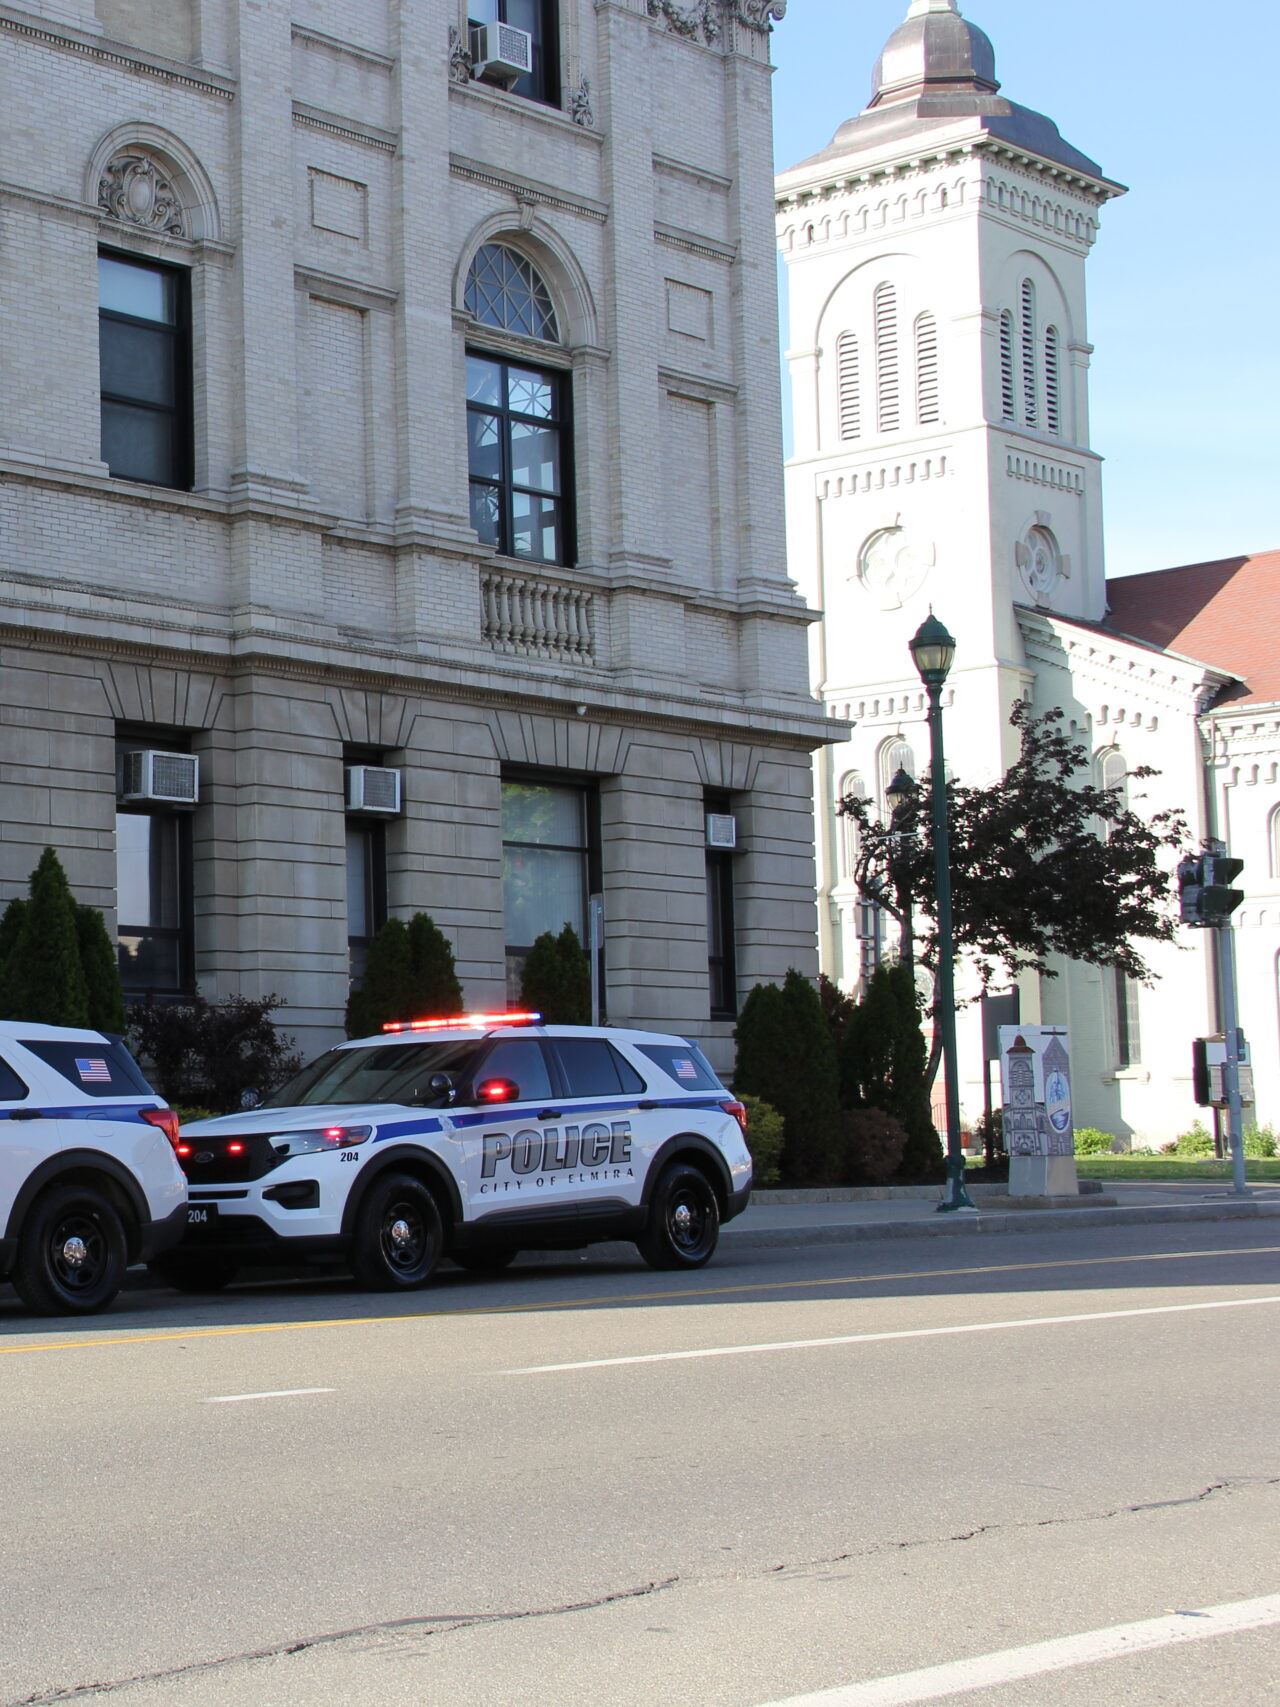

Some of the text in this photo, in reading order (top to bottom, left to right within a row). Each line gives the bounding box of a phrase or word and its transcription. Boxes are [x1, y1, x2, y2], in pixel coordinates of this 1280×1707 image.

[340, 1152, 359, 1162] 204
[481, 1121, 632, 1178] POLICE
[480, 1168, 634, 1194] CITY OF ELMIRA
[188, 1209, 208, 1223] 204
